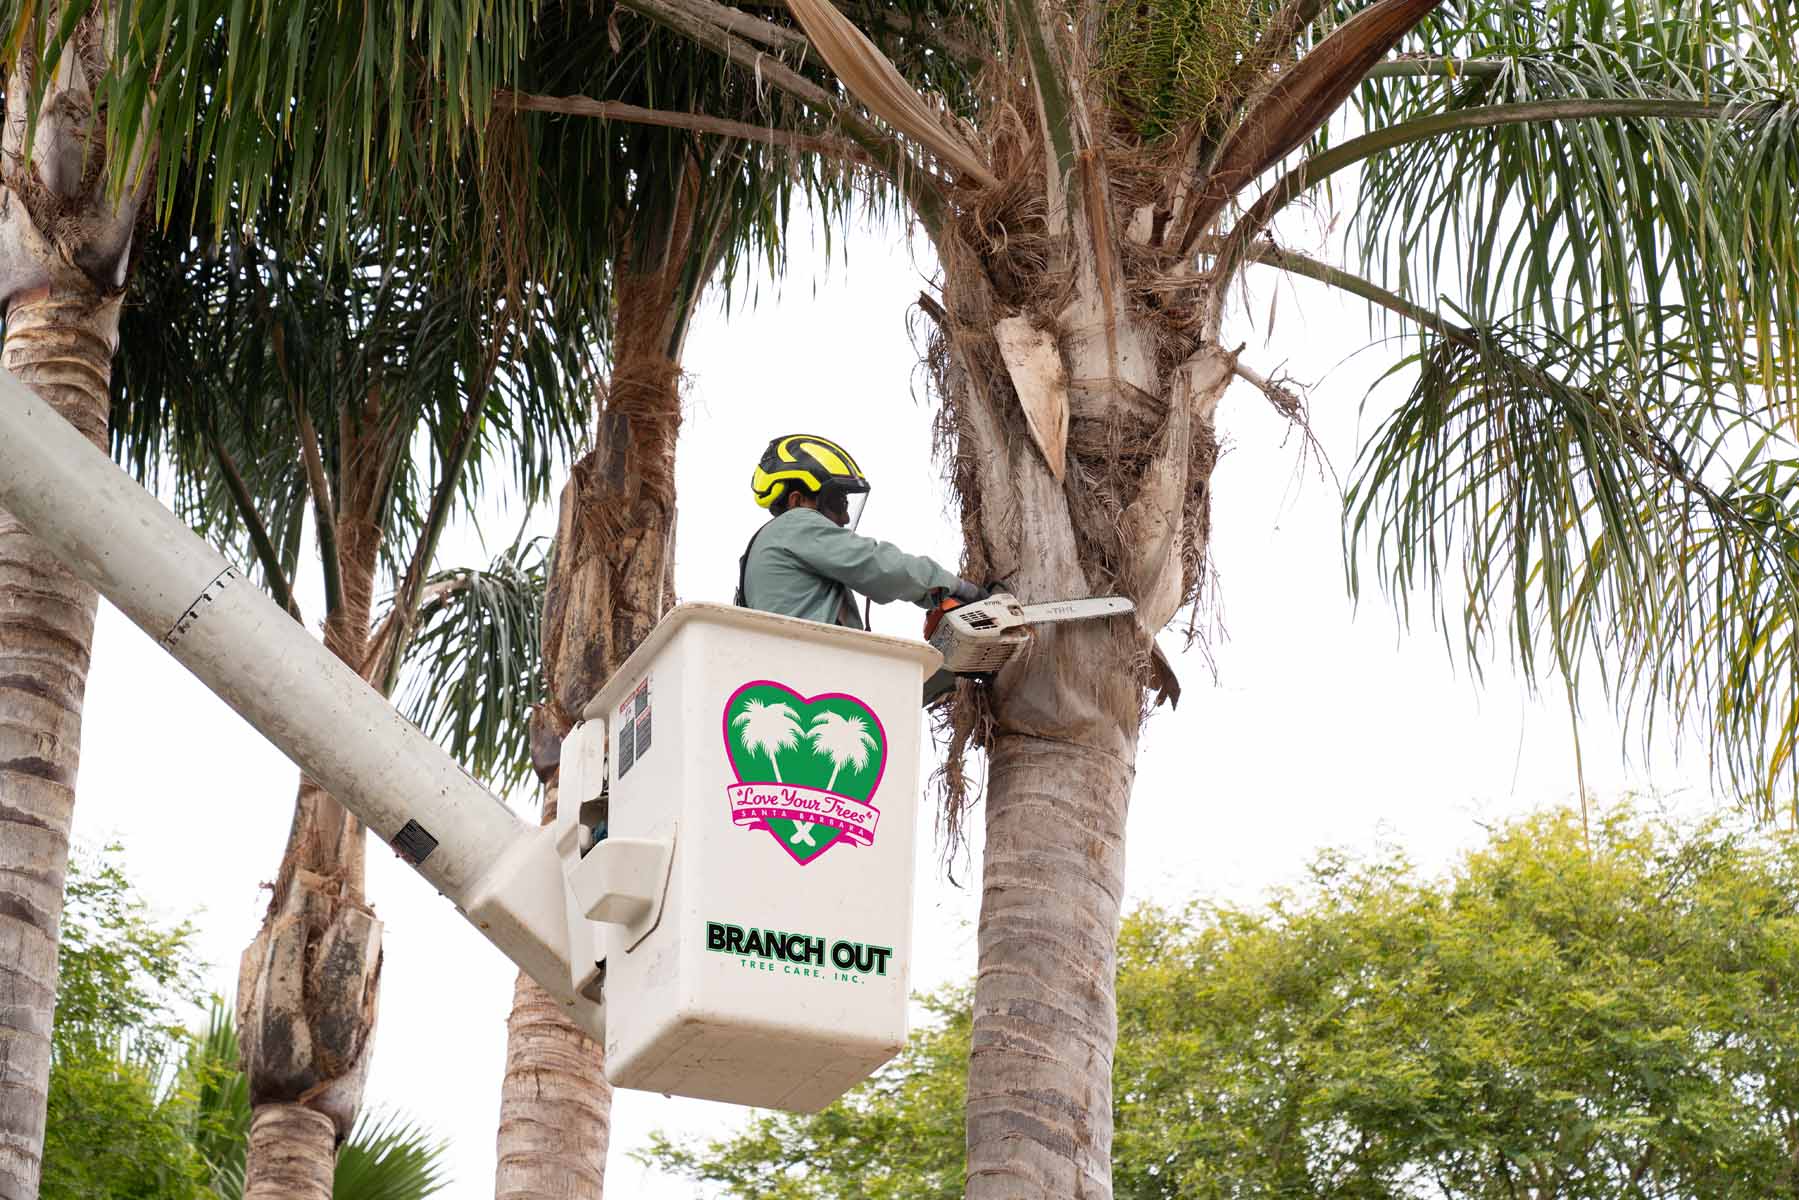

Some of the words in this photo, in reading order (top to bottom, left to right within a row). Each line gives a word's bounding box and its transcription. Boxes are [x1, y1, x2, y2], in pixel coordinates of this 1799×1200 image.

[781, 789, 821, 811] Your
[741, 809, 787, 817] SANTA
[799, 812, 864, 836] BARBARA
[706, 921, 826, 967] BRANCH
[830, 940, 893, 976] OUT
[740, 959, 775, 972] TREE
[834, 972, 865, 985] INC.
